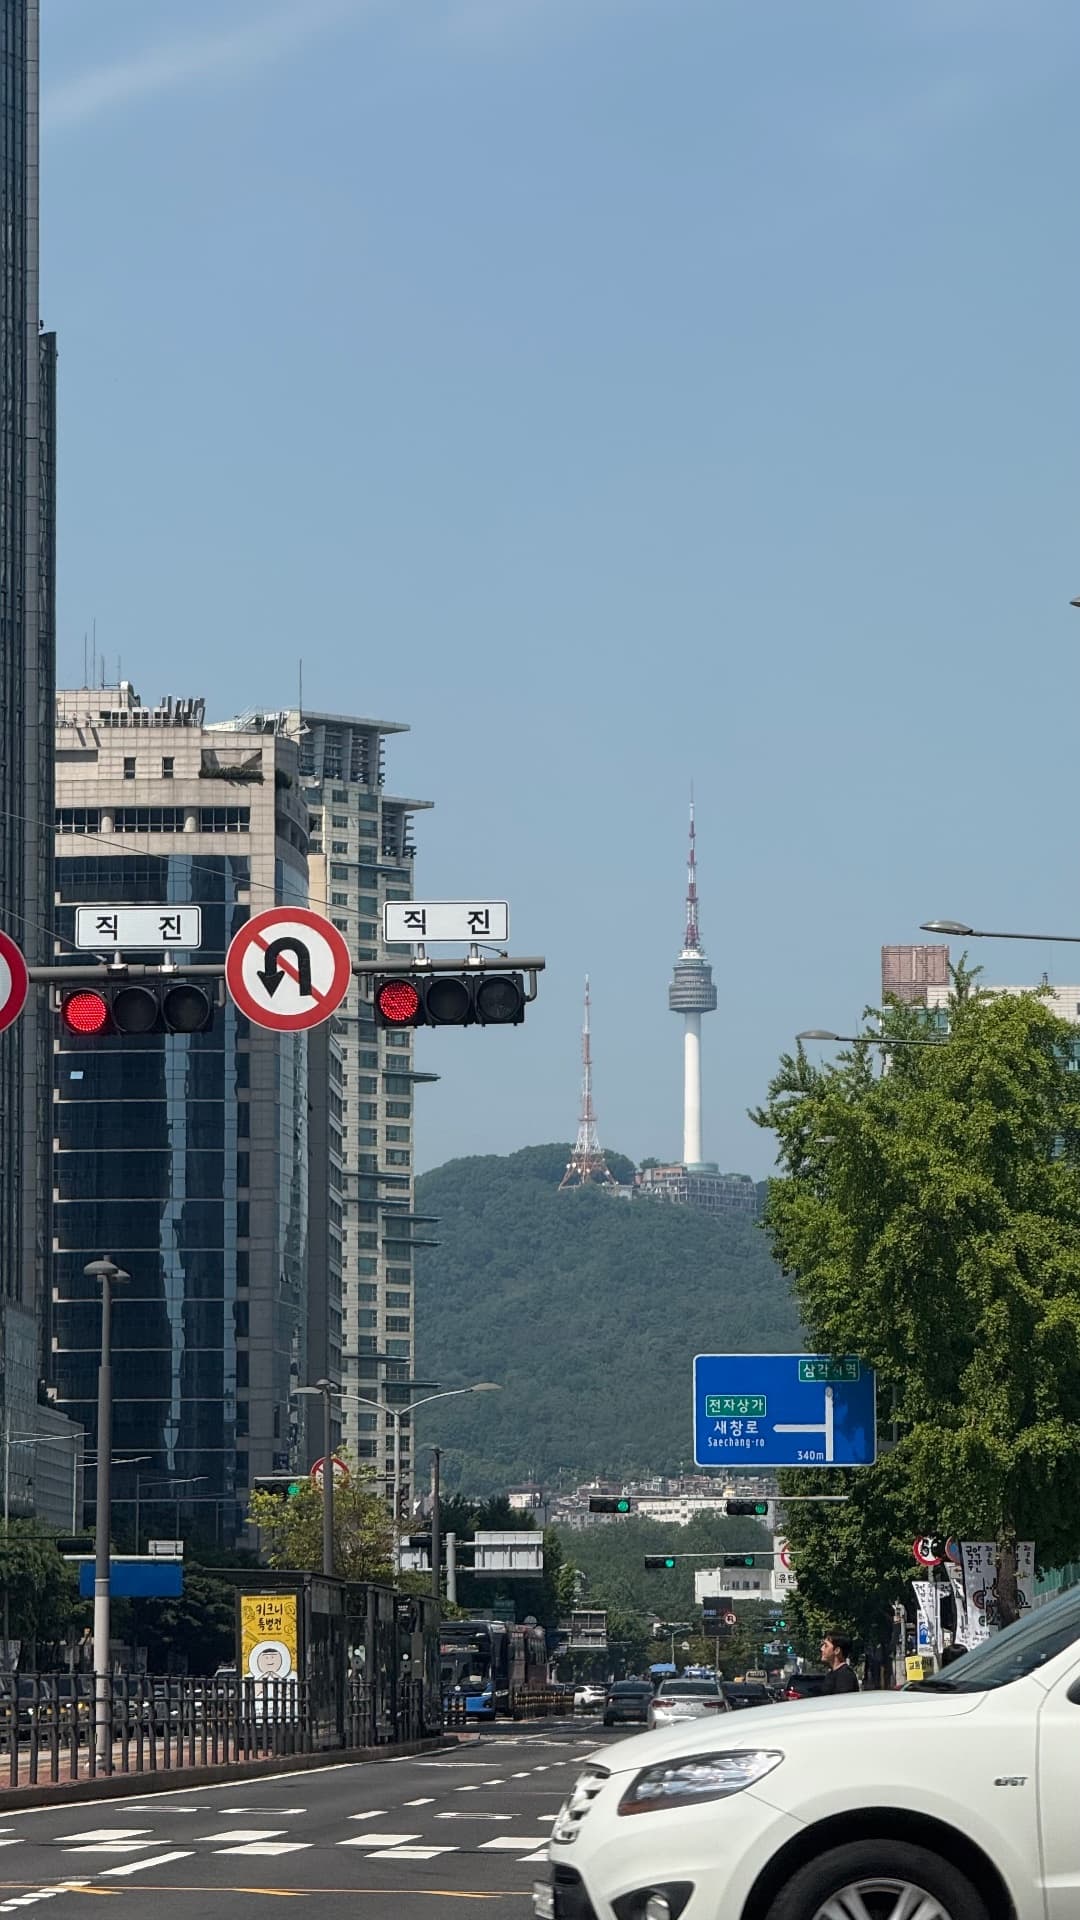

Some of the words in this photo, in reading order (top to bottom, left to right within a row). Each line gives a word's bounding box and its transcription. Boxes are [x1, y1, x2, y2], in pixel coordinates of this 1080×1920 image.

[709, 1399, 763, 1413] 전자상가
[714, 1420, 759, 1436] 새창로
[707, 1437, 765, 1448] Saechang-ro
[797, 1450, 825, 1461] 340m
[256, 1602, 283, 1616] 키크니
[258, 1617, 283, 1631] 특별전
